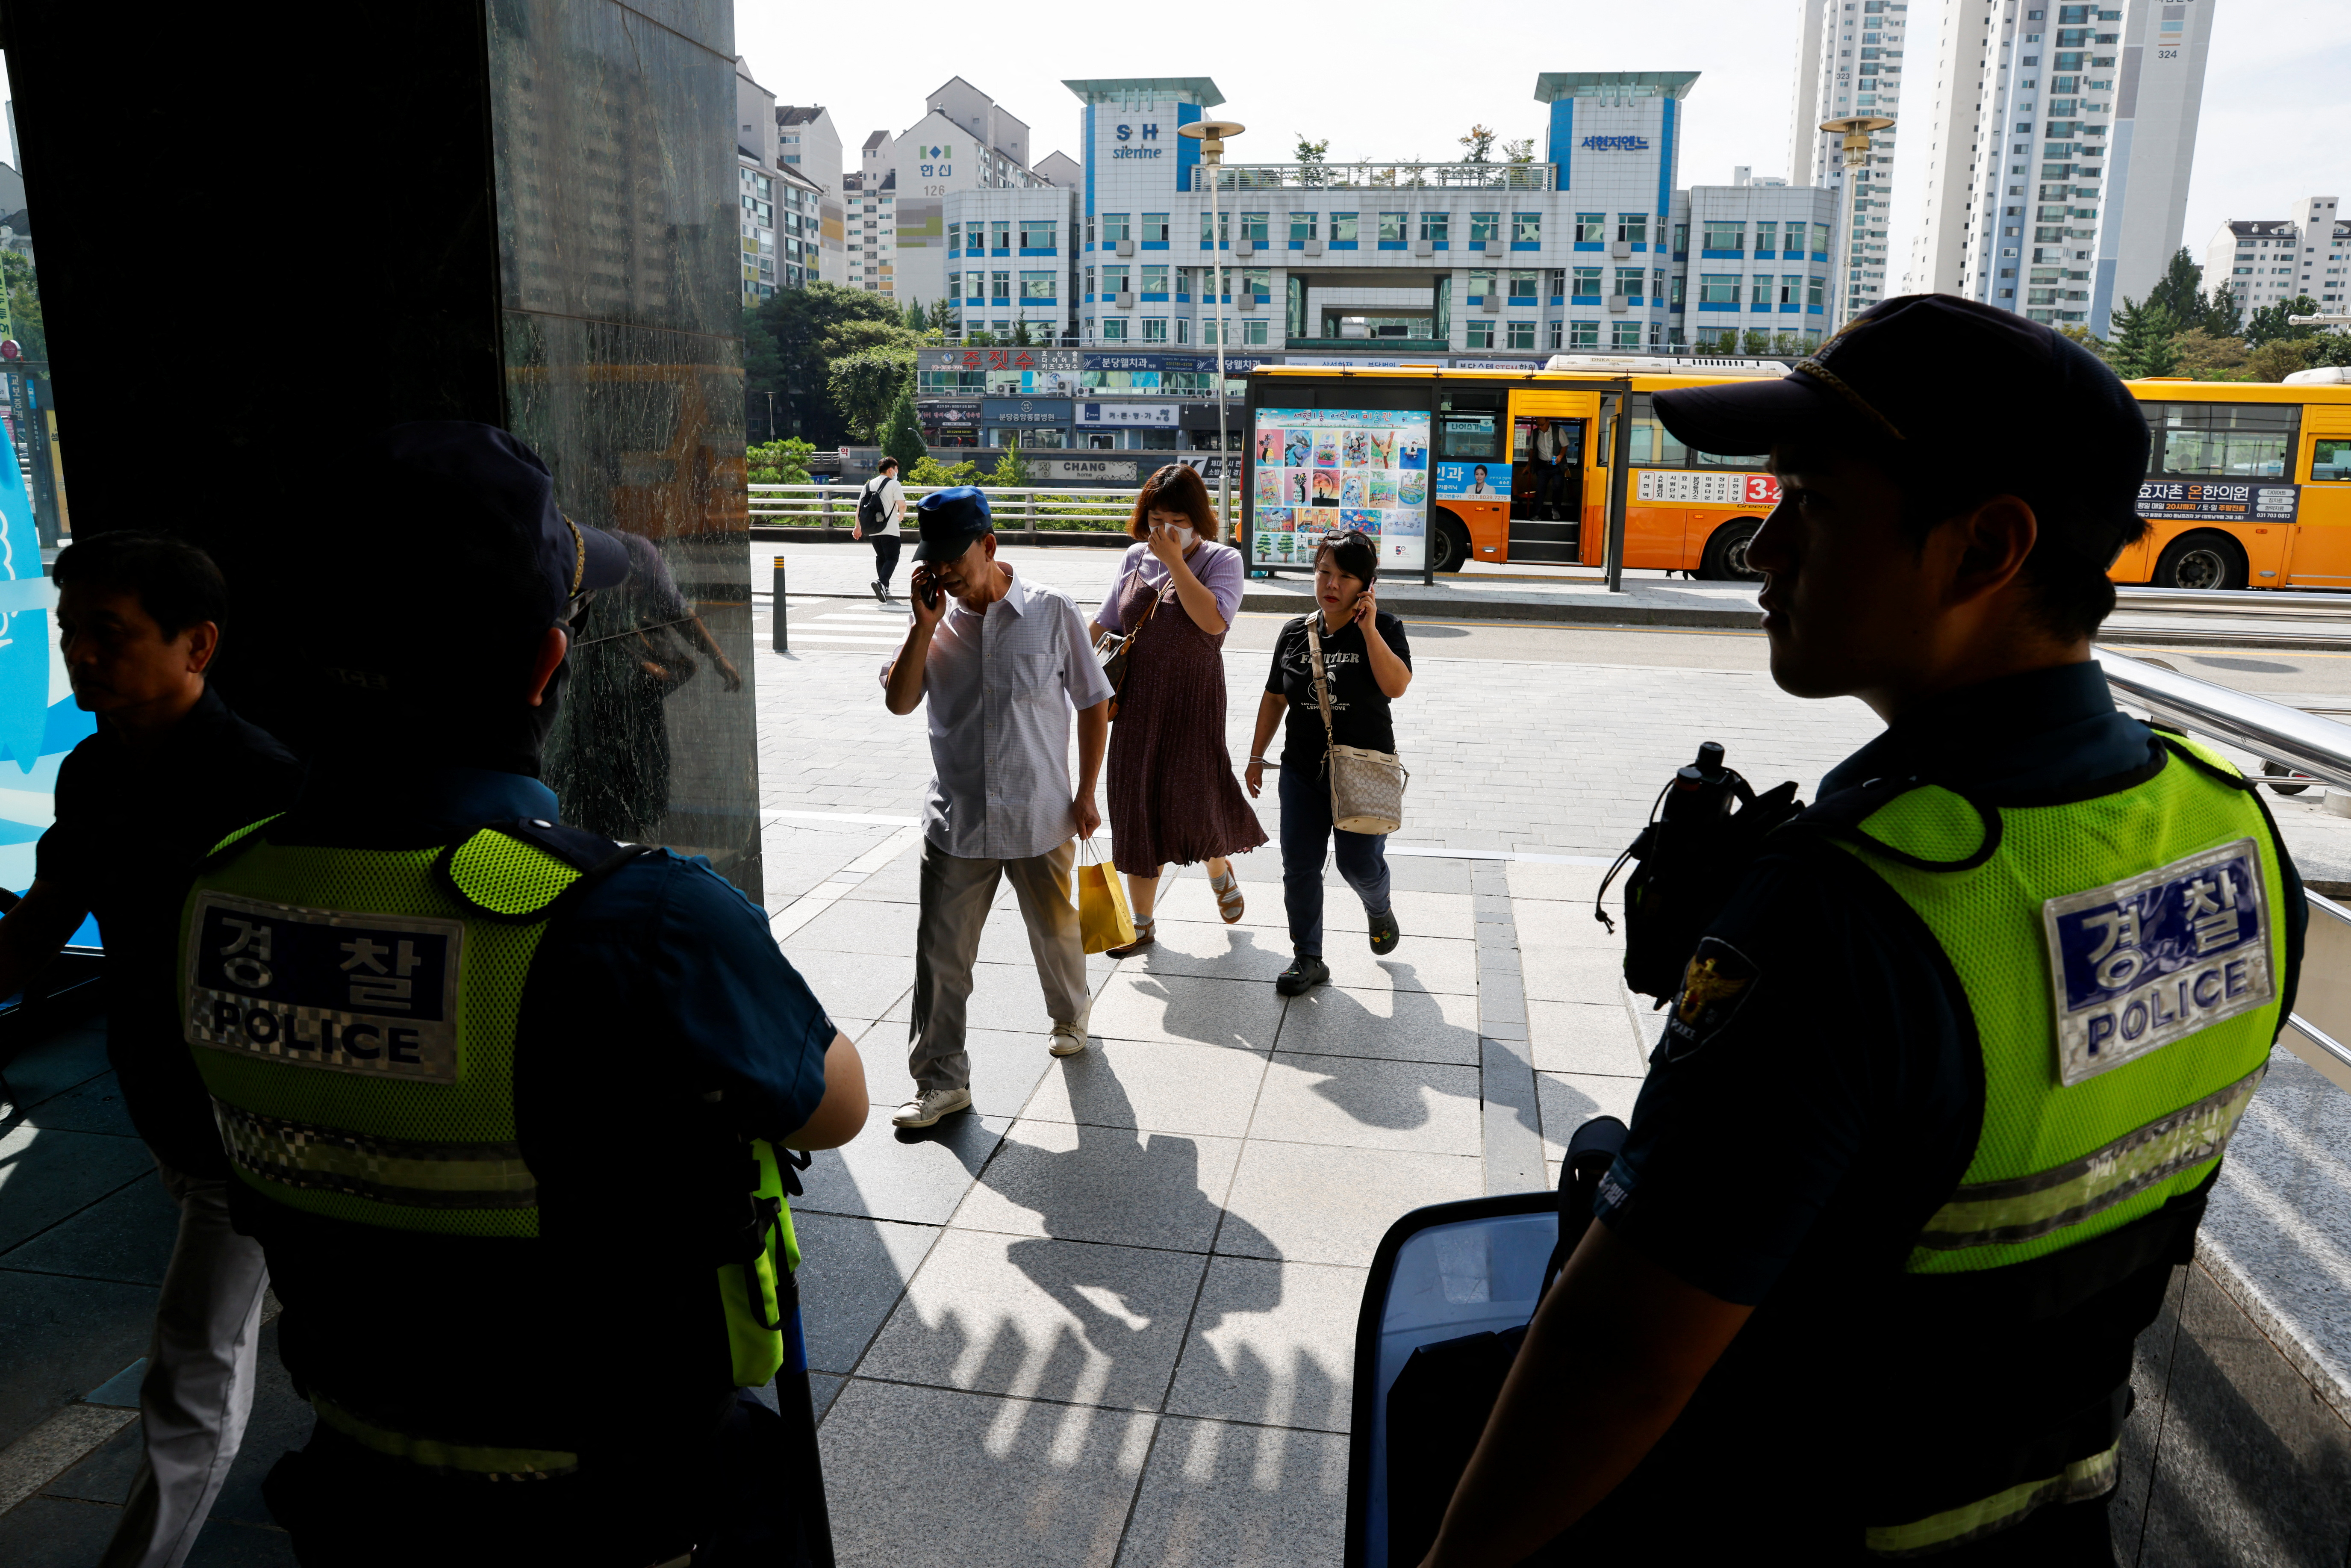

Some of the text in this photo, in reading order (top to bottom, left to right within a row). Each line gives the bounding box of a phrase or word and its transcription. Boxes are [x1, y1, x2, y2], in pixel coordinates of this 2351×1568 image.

[1582, 136, 1649, 151] 서현지엔느
[1113, 145, 1162, 159] sienne
[920, 164, 952, 177] 한신
[924, 185, 945, 196] 126
[961, 351, 1035, 371] 주짓수
[1102, 357, 1147, 368] 분당웰치과
[999, 413, 1055, 421] 분당중앙동물병원
[1330, 411, 1359, 421] 어린이
[1362, 412, 1392, 424] 미술관
[841, 448, 848, 456] 약
[1064, 462, 1106, 471] CHANG
[1642, 474, 1650, 498] 서현역
[2137, 483, 2249, 501] 효자촌 온한의원
[2218, 504, 2246, 512] 주말진료
[2082, 869, 2240, 990] 경찰
[220, 916, 421, 1010] 경찰
[2087, 959, 2247, 1058] POLICE
[214, 999, 421, 1064] POLICE
